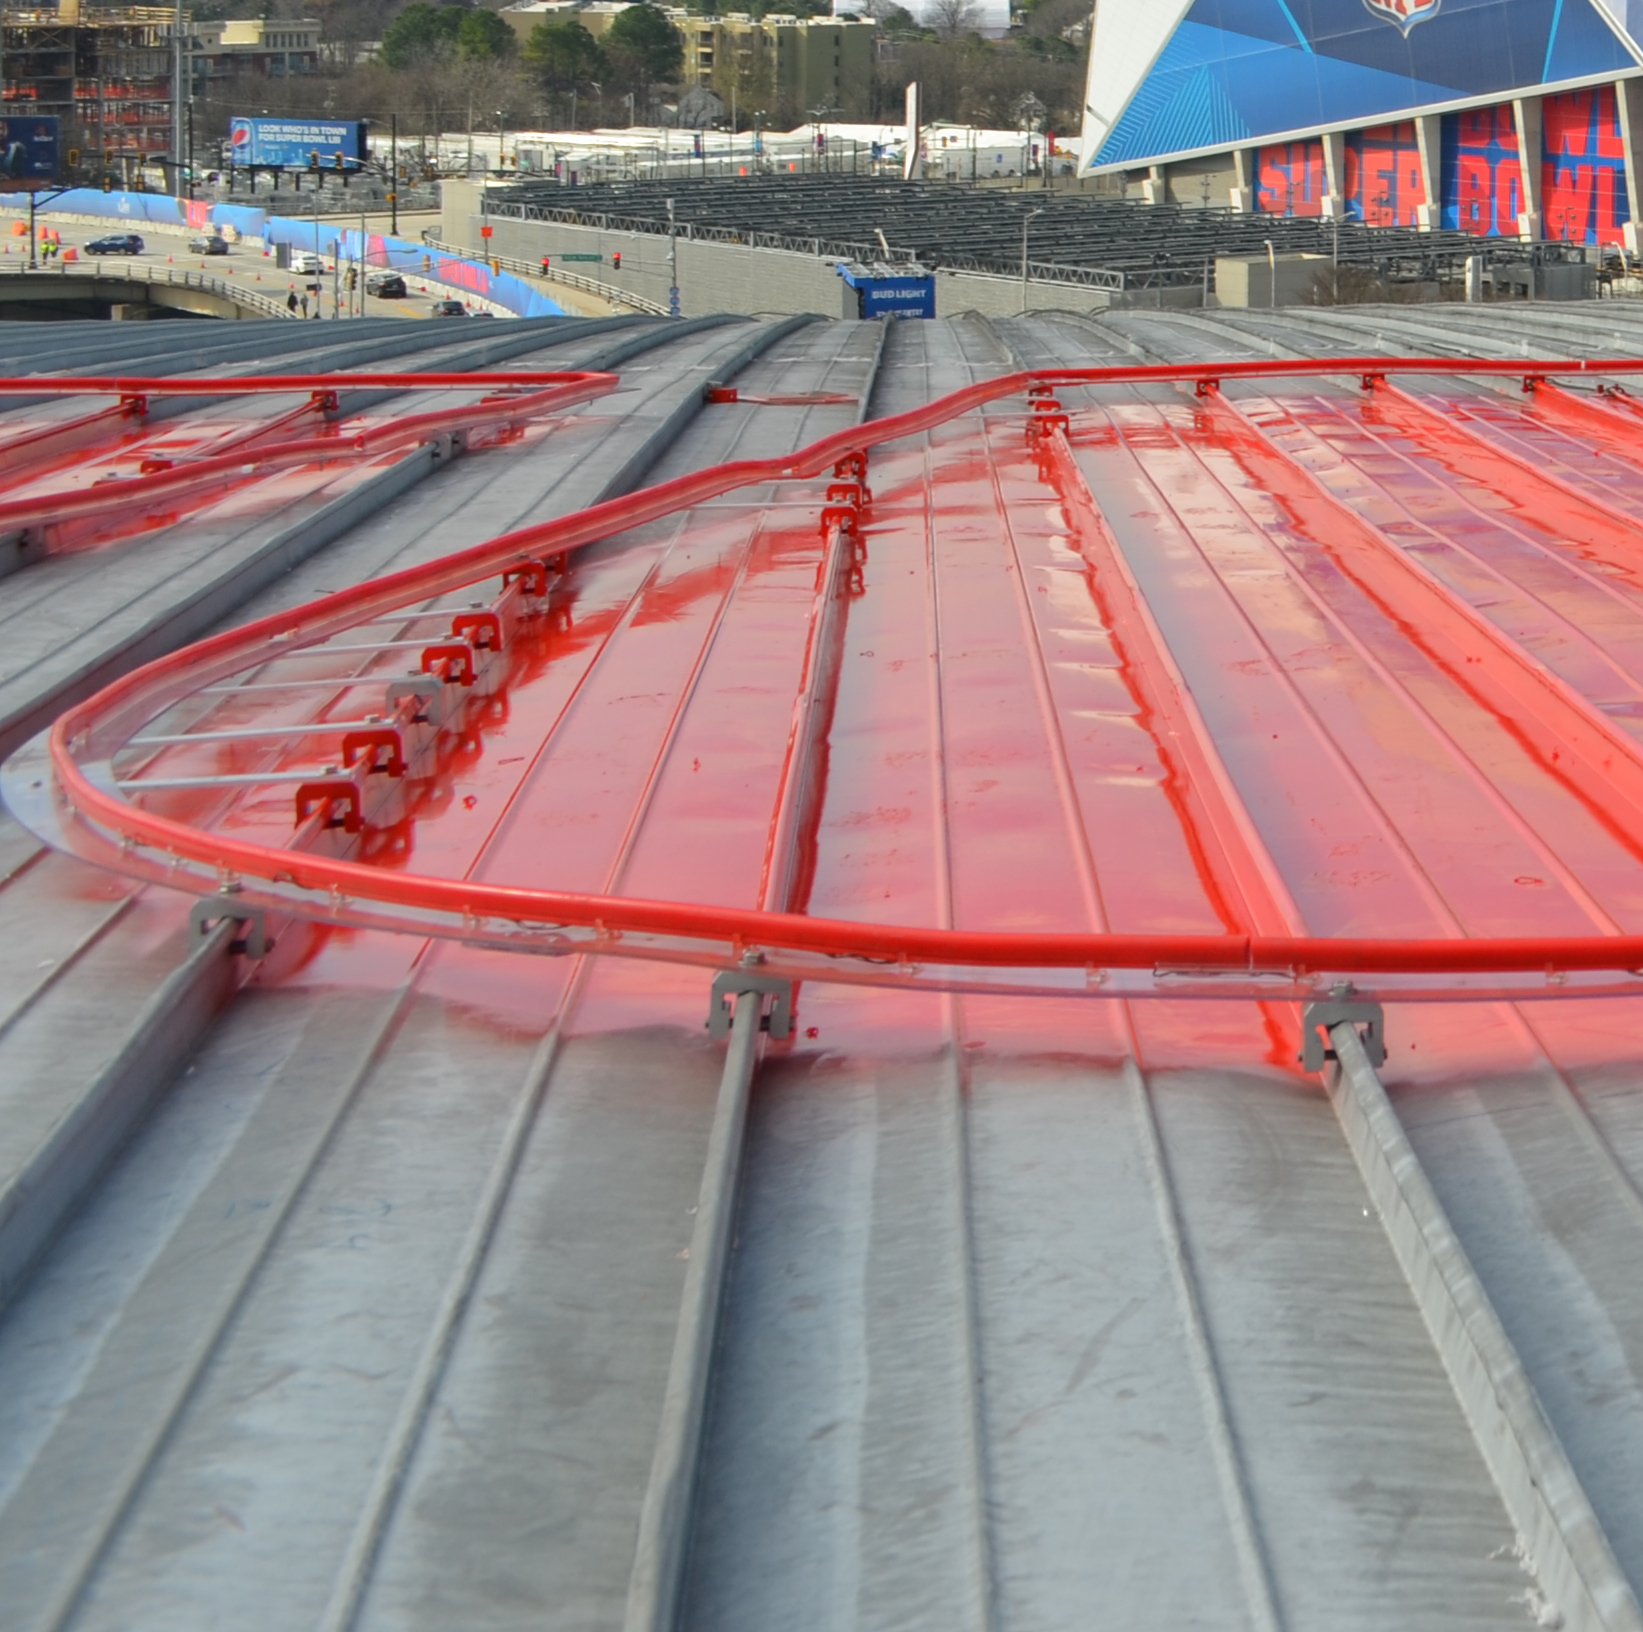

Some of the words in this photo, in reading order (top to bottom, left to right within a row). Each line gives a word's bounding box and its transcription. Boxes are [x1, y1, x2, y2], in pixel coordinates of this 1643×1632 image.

[258, 125, 281, 133] LOOK
[282, 126, 309, 134] WHO'S
[320, 127, 347, 136] TOWN
[275, 133, 302, 143] SUPER
[302, 134, 327, 144] BOWL
[1458, 154, 1626, 249] BOWL
[872, 290, 895, 299] BUD
[896, 289, 927, 299] LIGHT
